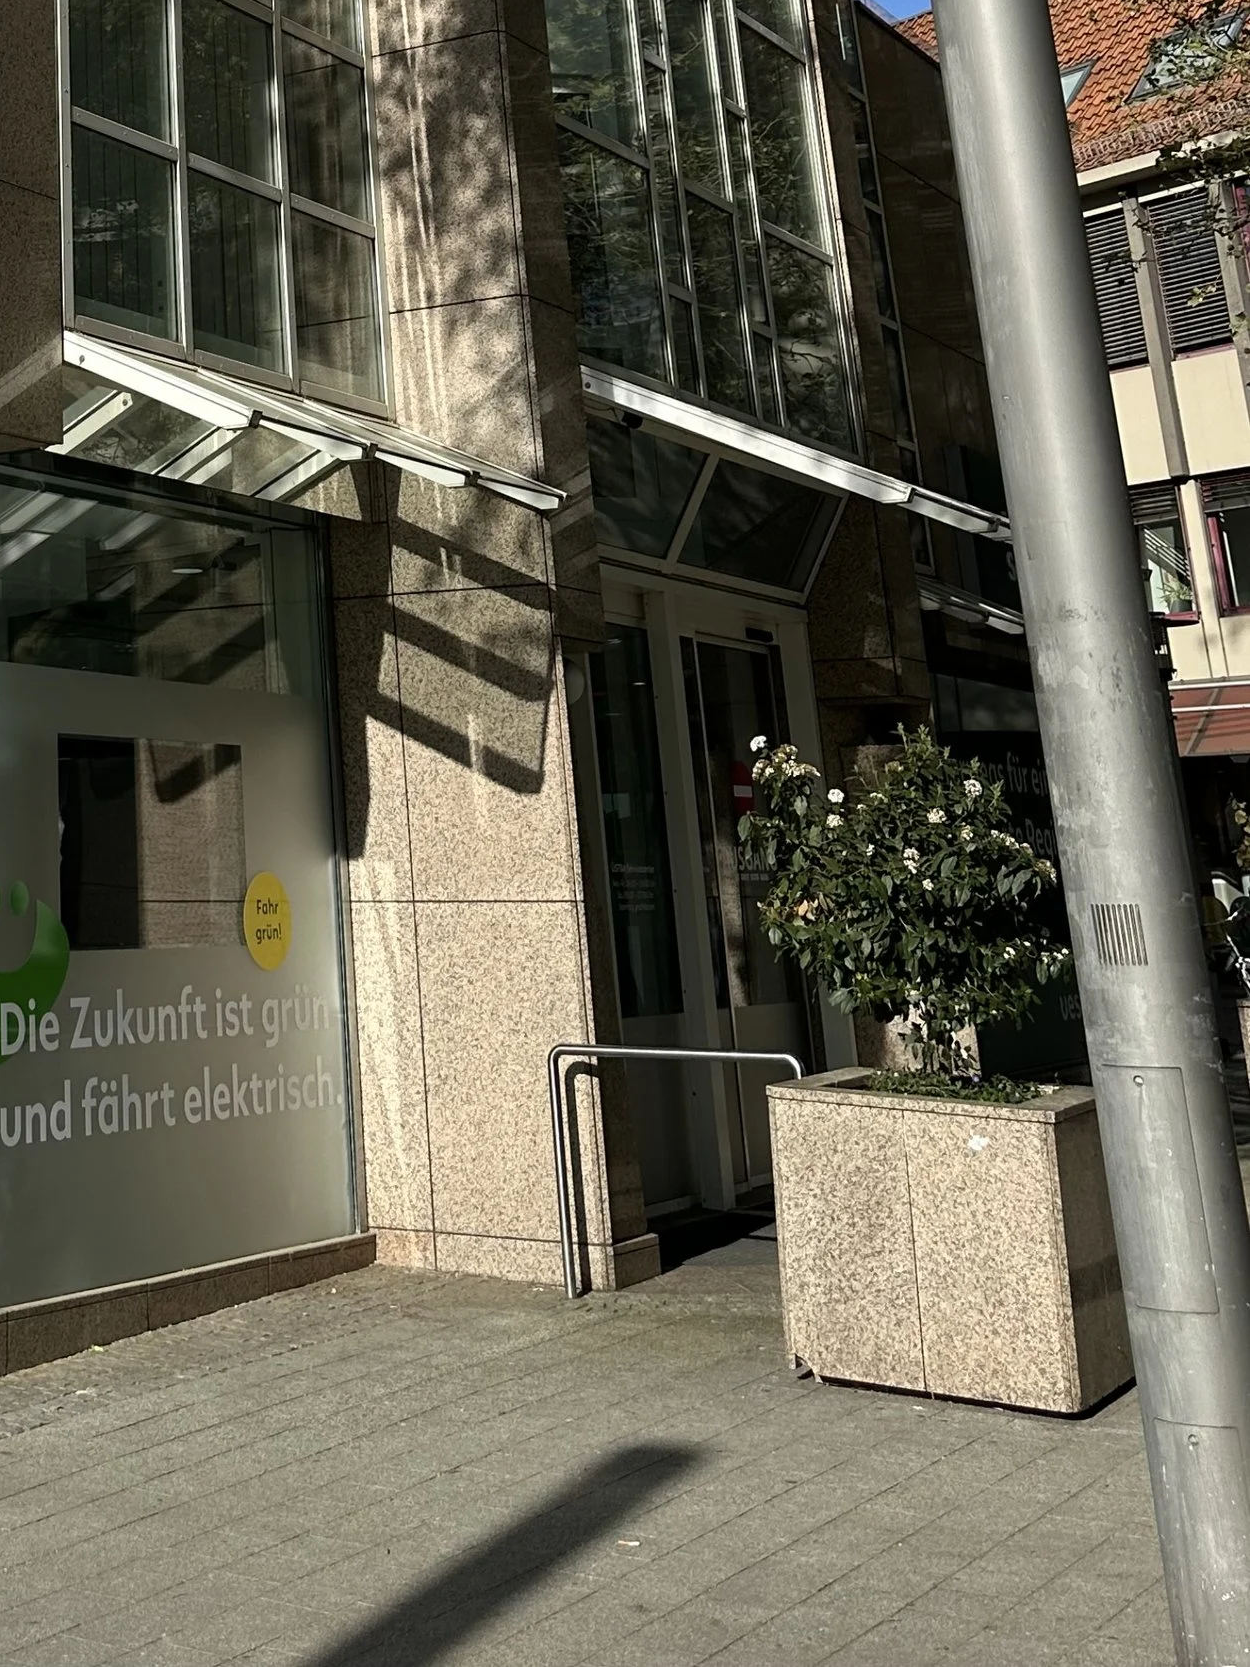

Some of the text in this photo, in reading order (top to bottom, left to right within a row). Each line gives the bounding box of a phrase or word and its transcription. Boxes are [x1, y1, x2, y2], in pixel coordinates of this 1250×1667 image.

[256, 898, 279, 915] Fahr
[255, 923, 282, 944] grün!
[0, 984, 330, 1056] Die Zukunft ist grün
[0, 1055, 343, 1147] und fährt elektrisch.
